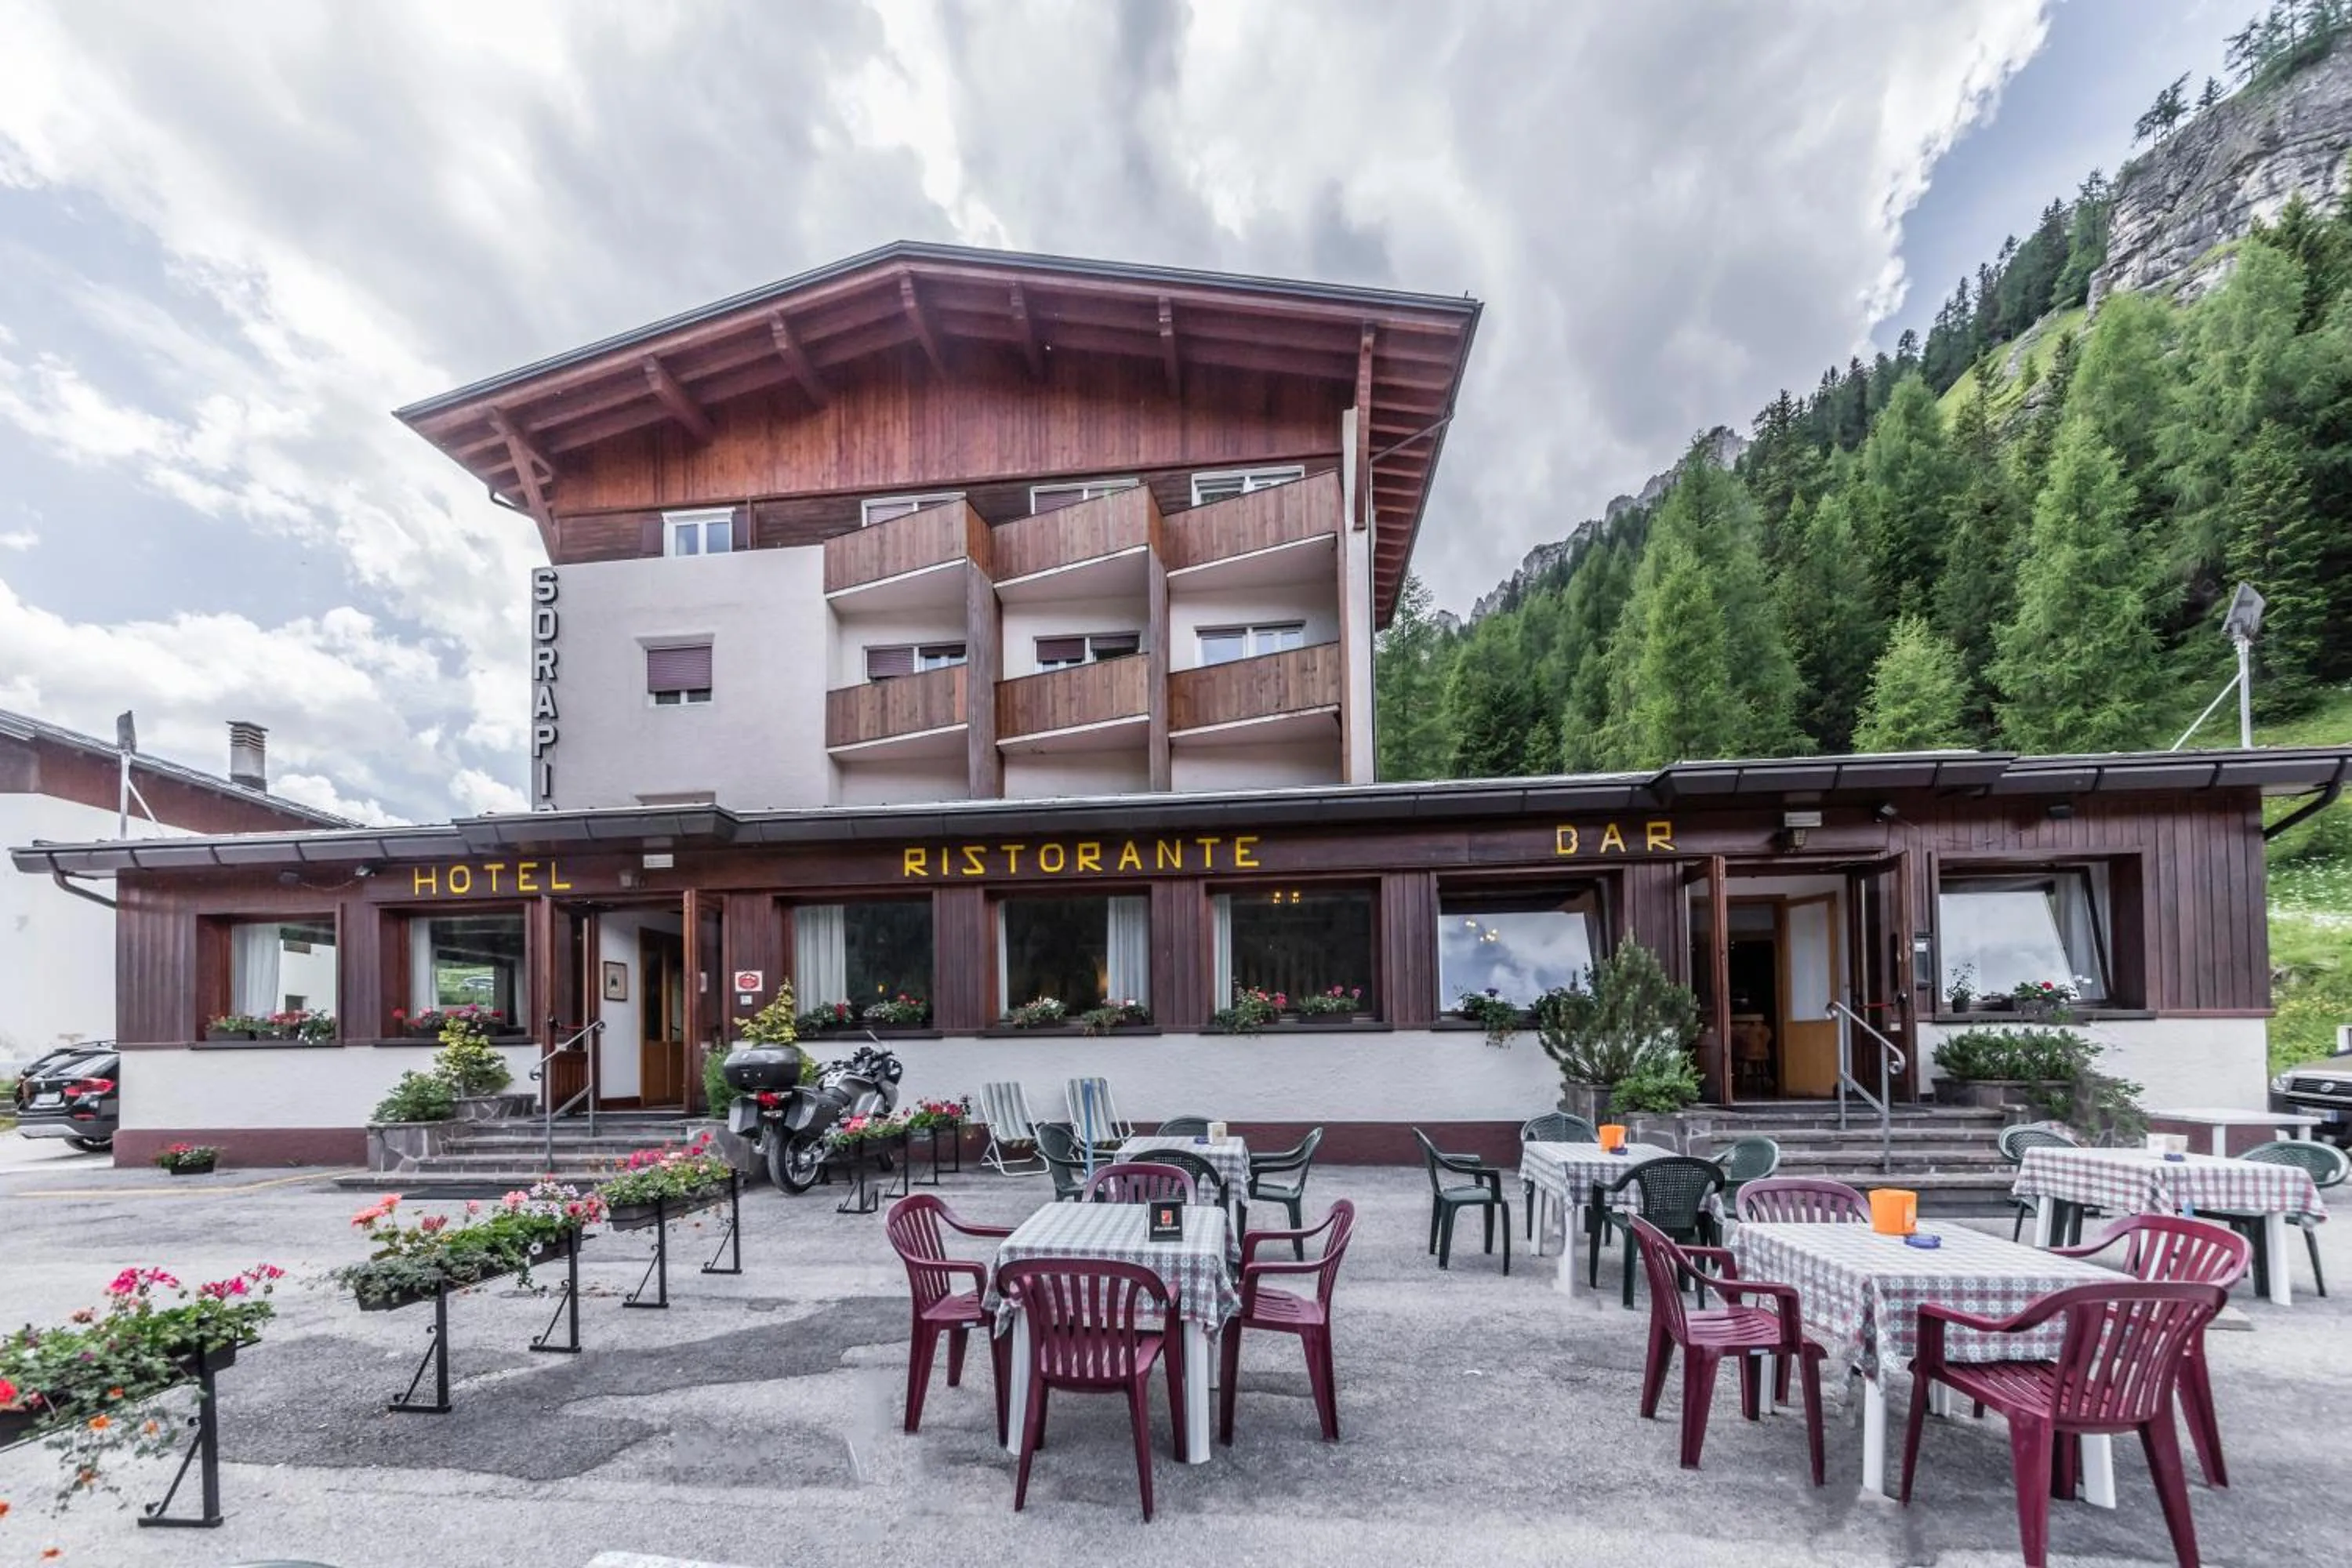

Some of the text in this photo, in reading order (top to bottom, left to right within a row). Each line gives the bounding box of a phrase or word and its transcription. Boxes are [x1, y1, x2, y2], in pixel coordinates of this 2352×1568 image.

[532, 569, 557, 811] SORAPI
[903, 836, 1260, 877] RISTORANTE
[1555, 821, 1676, 855] BAR
[413, 861, 573, 895] HOTEL
